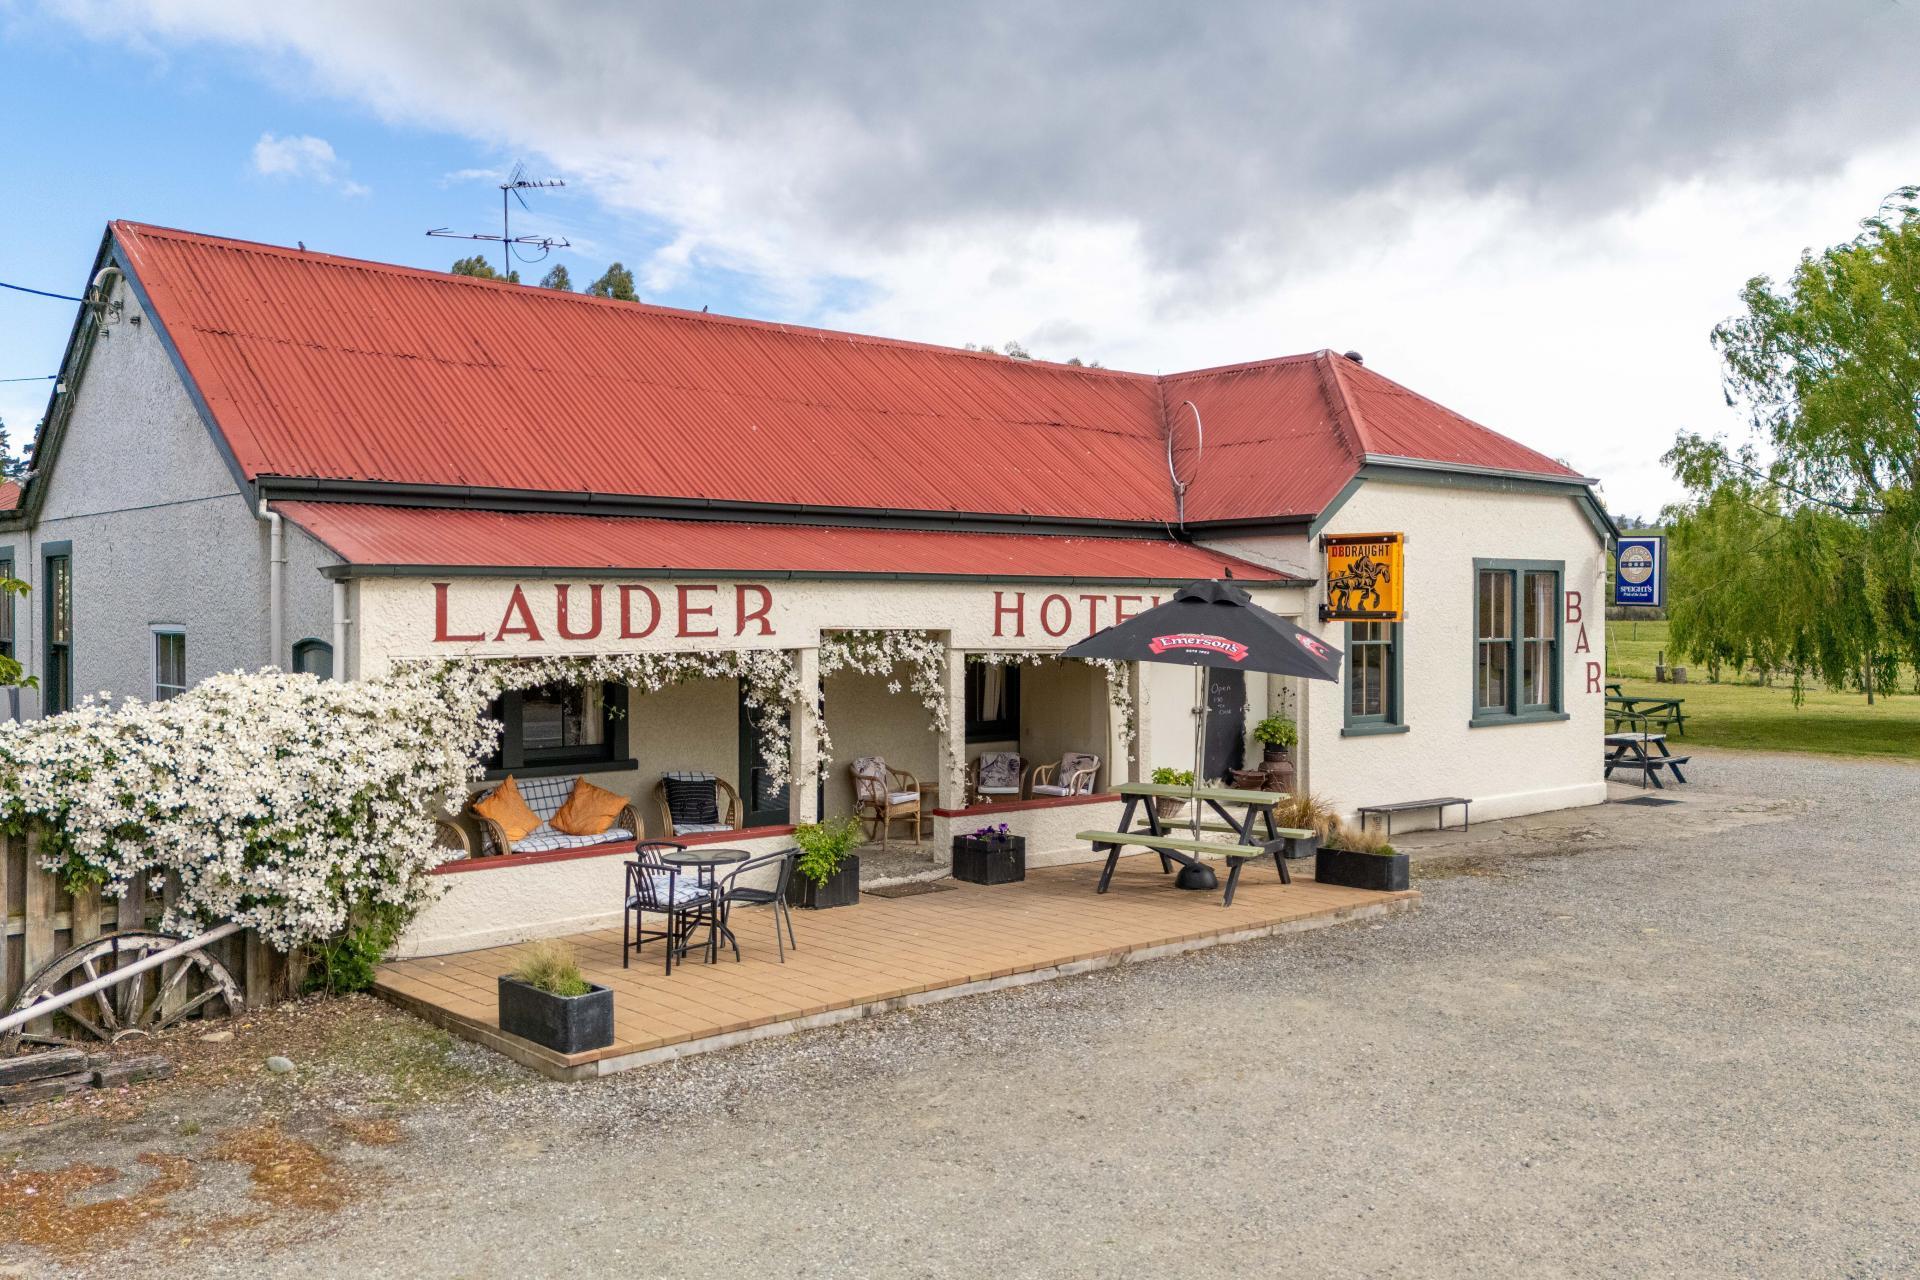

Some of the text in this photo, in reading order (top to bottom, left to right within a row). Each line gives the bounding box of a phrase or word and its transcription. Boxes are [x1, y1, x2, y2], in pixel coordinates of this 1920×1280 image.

[432, 583, 1160, 642] LAUDER HOTE
[1160, 637, 1240, 653] Emerson's
[1565, 591, 1601, 694] BAR
